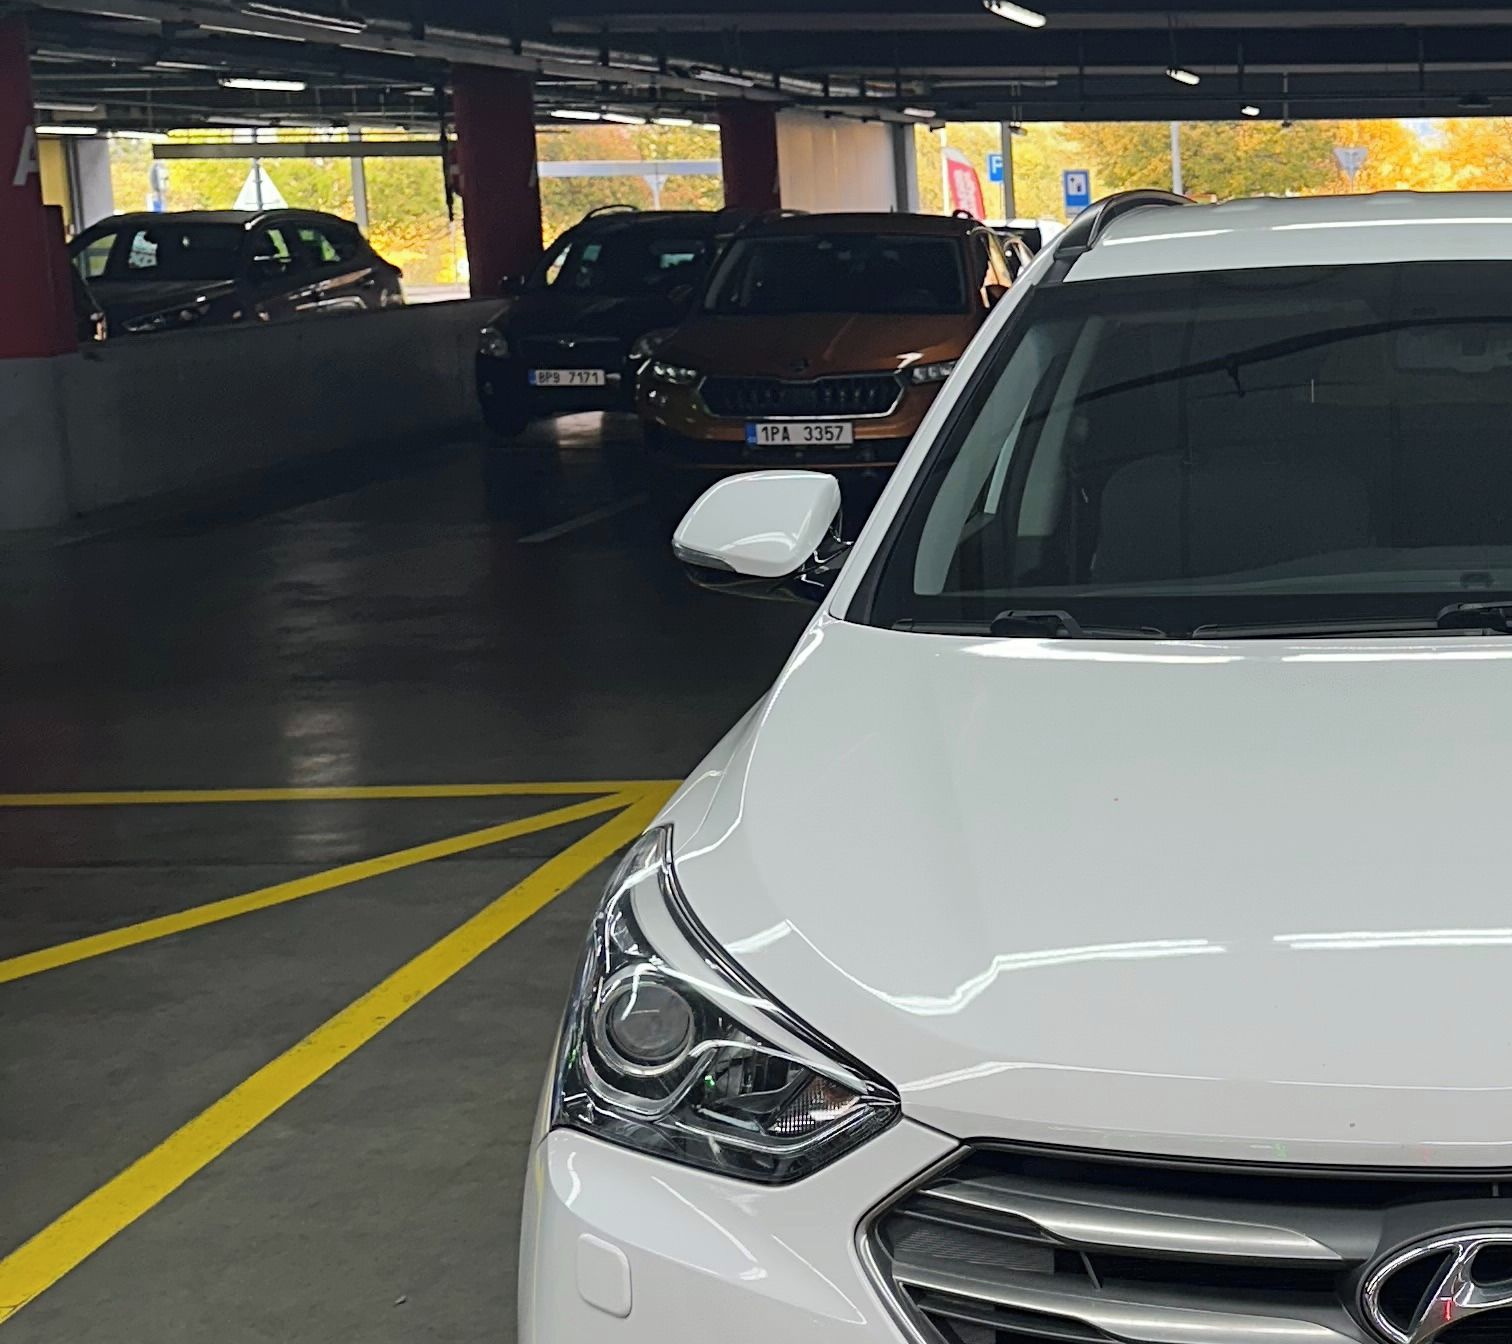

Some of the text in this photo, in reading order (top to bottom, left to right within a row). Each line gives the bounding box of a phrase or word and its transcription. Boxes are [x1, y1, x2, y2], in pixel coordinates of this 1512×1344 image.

[569, 371, 599, 384] 7171
[761, 425, 790, 442] 1PA
[803, 425, 844, 441] 3357
